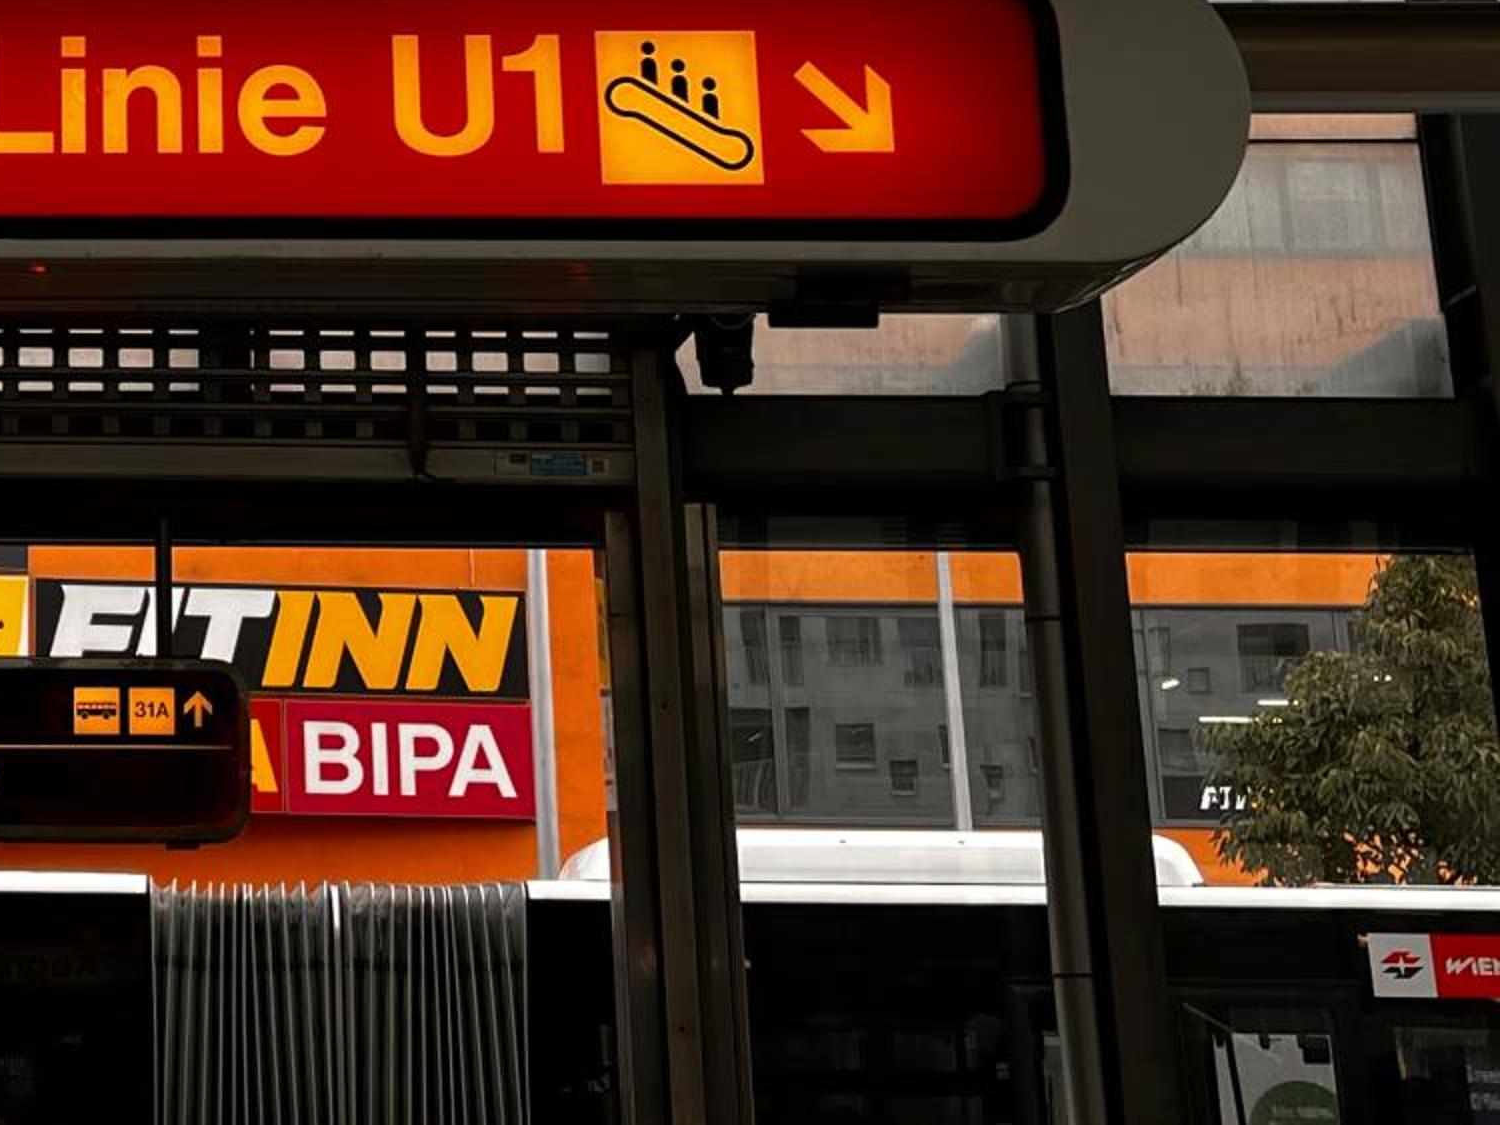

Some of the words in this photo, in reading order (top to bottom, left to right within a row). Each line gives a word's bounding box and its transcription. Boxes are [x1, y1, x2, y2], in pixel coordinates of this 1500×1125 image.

[392, 34, 565, 156] U1
[135, 700, 169, 718] 31A
[303, 720, 517, 797] BIPA
